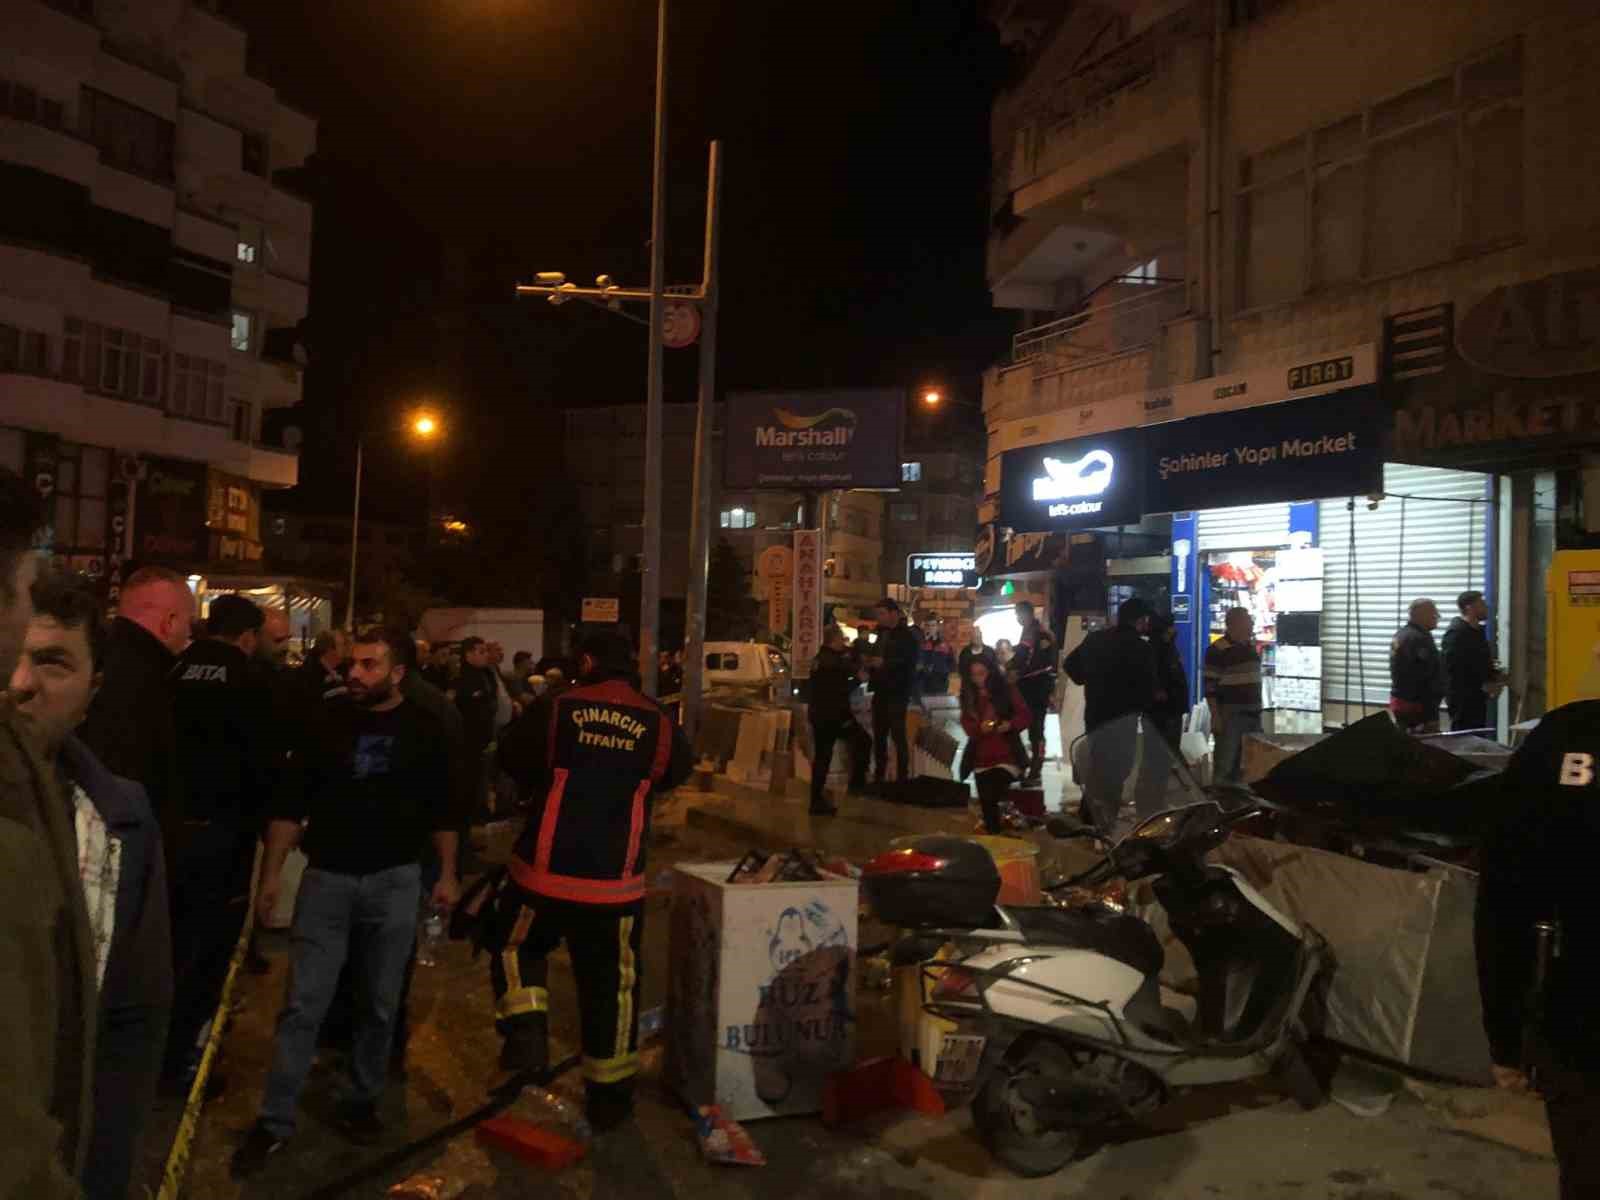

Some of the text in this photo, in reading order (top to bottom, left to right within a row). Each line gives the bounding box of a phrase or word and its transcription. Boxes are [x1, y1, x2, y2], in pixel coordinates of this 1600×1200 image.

[1288, 356, 1352, 390] FIRAT
[755, 425, 847, 447] Marshall
[1159, 431, 1357, 480] Şahinler Yapı Market
